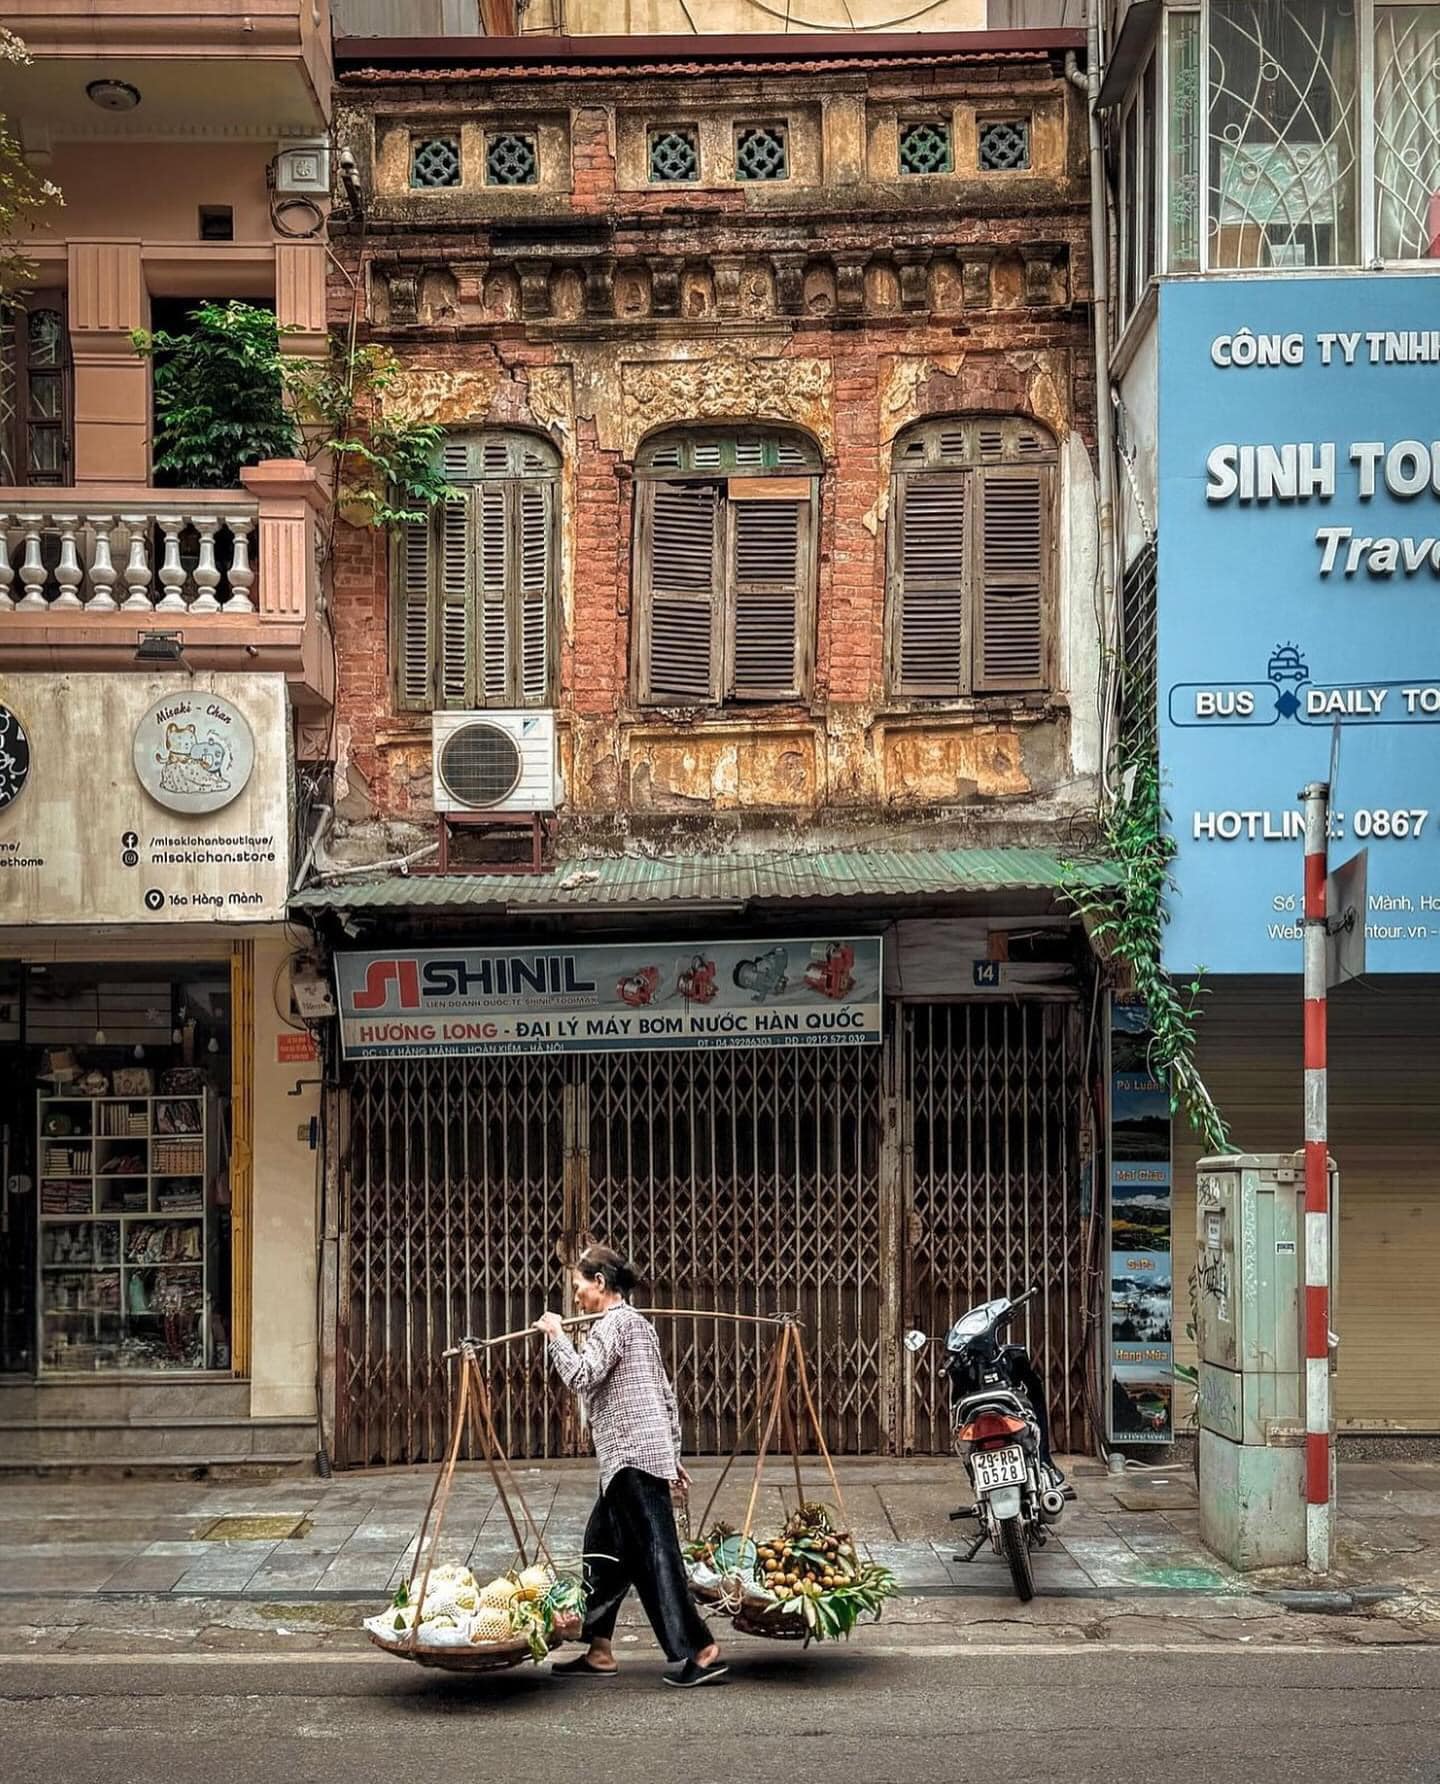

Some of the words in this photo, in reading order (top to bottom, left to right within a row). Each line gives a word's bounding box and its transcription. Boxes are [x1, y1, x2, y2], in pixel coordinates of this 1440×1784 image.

[1211, 327, 1304, 366] CÔNG
[1317, 332, 1361, 364] TY
[1205, 442, 1336, 502] SINH
[1349, 440, 1440, 500] TO
[156, 701, 192, 724] Misaki
[206, 704, 232, 724] Chan
[1195, 691, 1255, 716] BUS
[1306, 689, 1389, 715] DAILY
[1353, 808, 1429, 838] 0867
[192, 892, 224, 907] Hàng
[228, 891, 264, 905] Mành
[1273, 894, 1296, 911] Số
[422, 955, 596, 997] SHINIL
[976, 964, 995, 982] 14
[361, 1022, 436, 1042] HƯƠNG
[443, 1022, 498, 1041] LONG
[515, 1020, 551, 1040] ĐẠI
[558, 1016, 578, 1036] LÝ
[586, 1014, 632, 1036] MÁY
[639, 1015, 683, 1034] BƠM
[690, 1011, 749, 1032] NƯỚC
[755, 1010, 799, 1031] HÀN
[805, 1005, 865, 1029] QUỐC
[982, 1465, 1018, 1485] 0528
